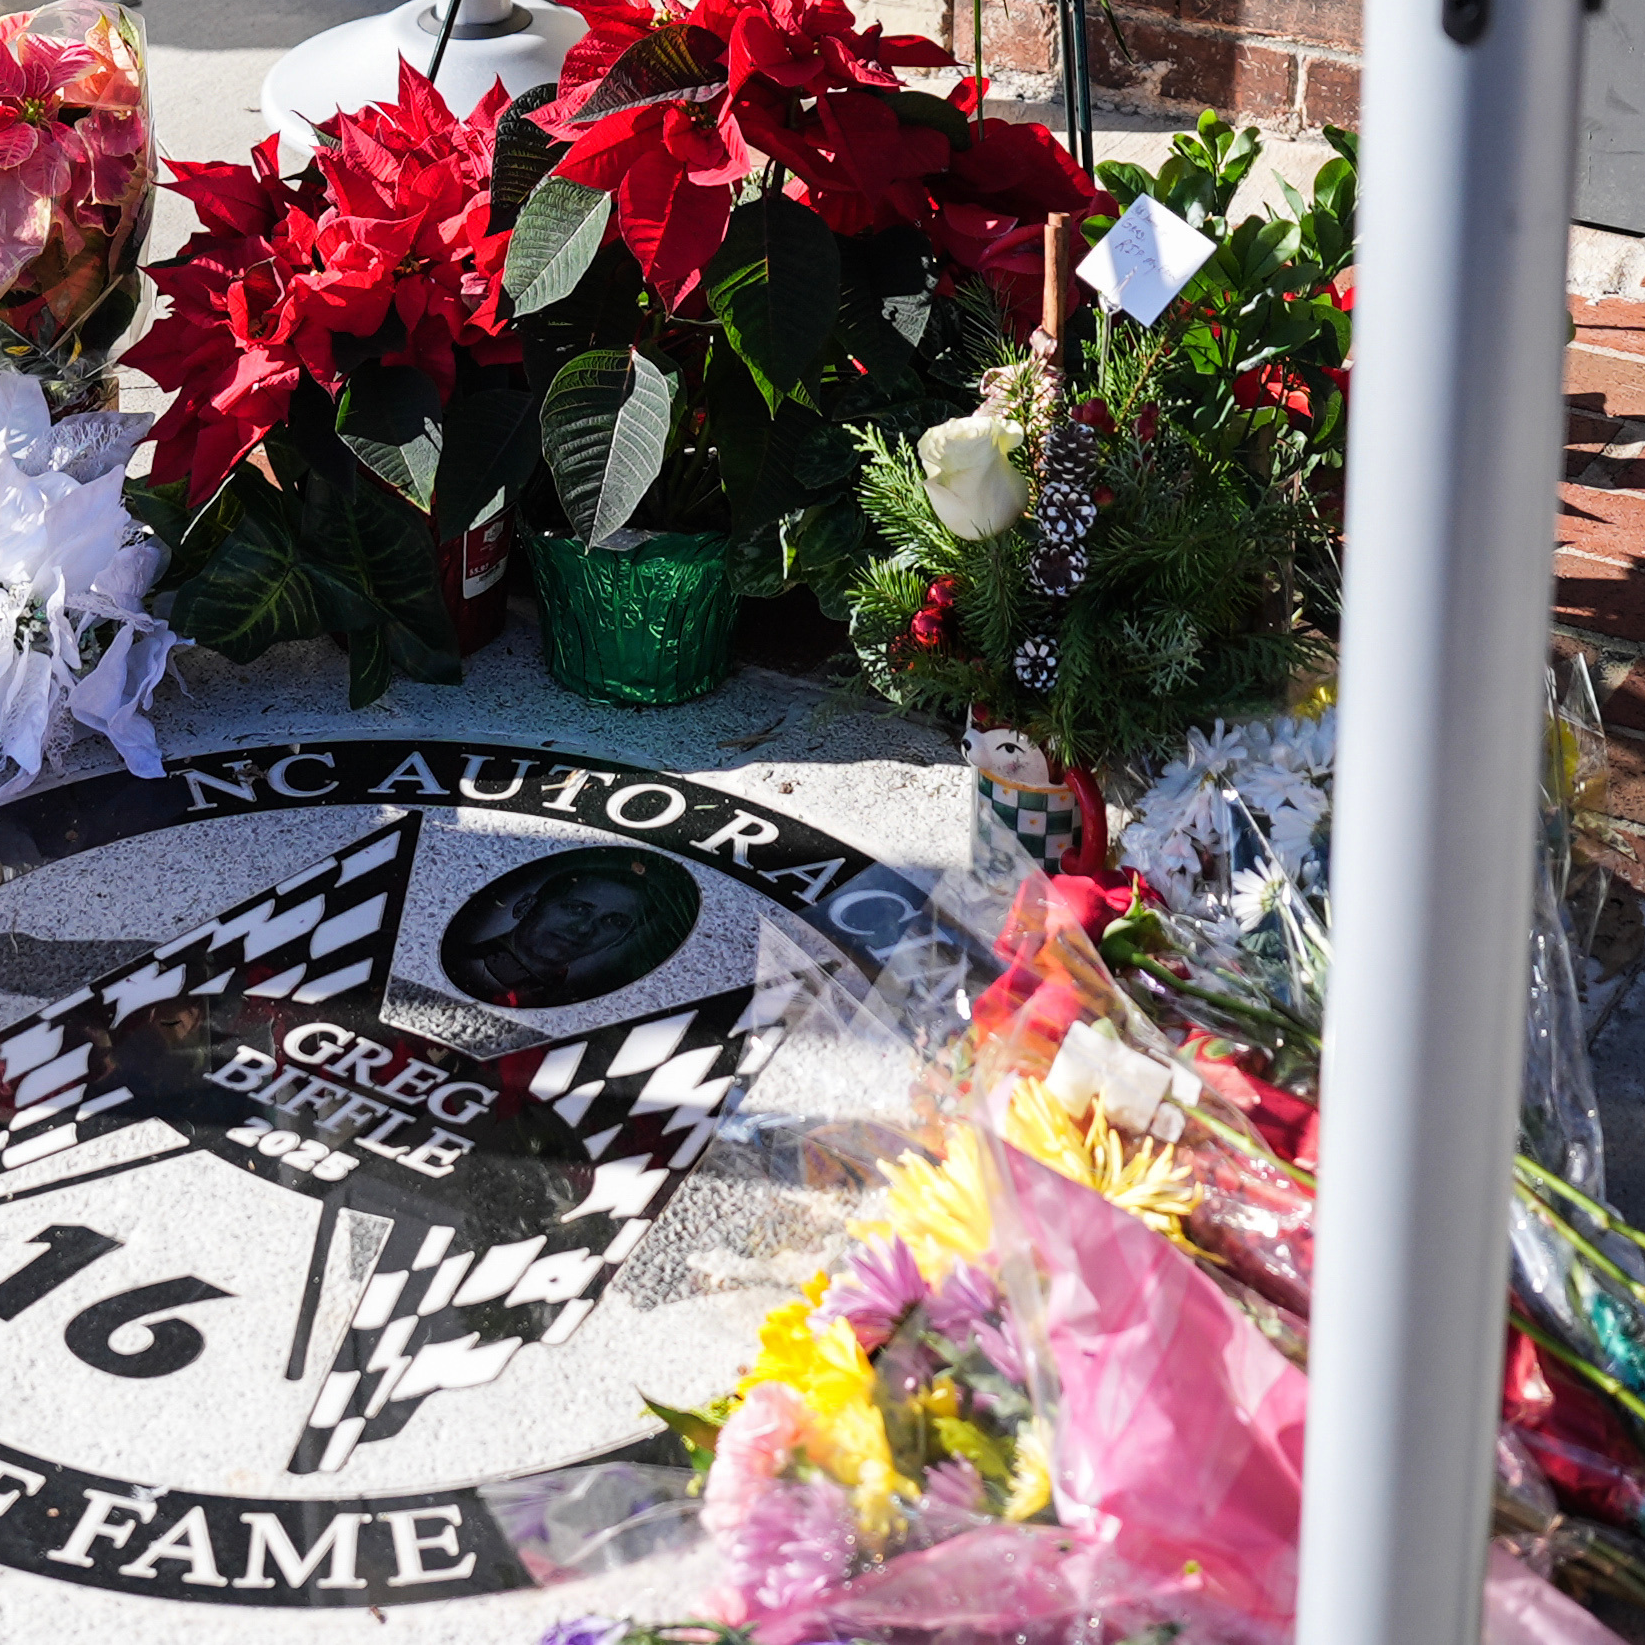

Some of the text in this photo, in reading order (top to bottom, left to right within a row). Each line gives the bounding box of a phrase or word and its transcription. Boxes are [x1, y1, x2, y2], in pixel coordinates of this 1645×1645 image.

[169, 751, 336, 811] NC
[367, 751, 688, 832] AUTO
[203, 1045, 476, 1179] BIFFLE
[282, 1022, 500, 1125] GREG
[225, 1116, 360, 1182] 2025
[46, 1488, 477, 1590] FAME
